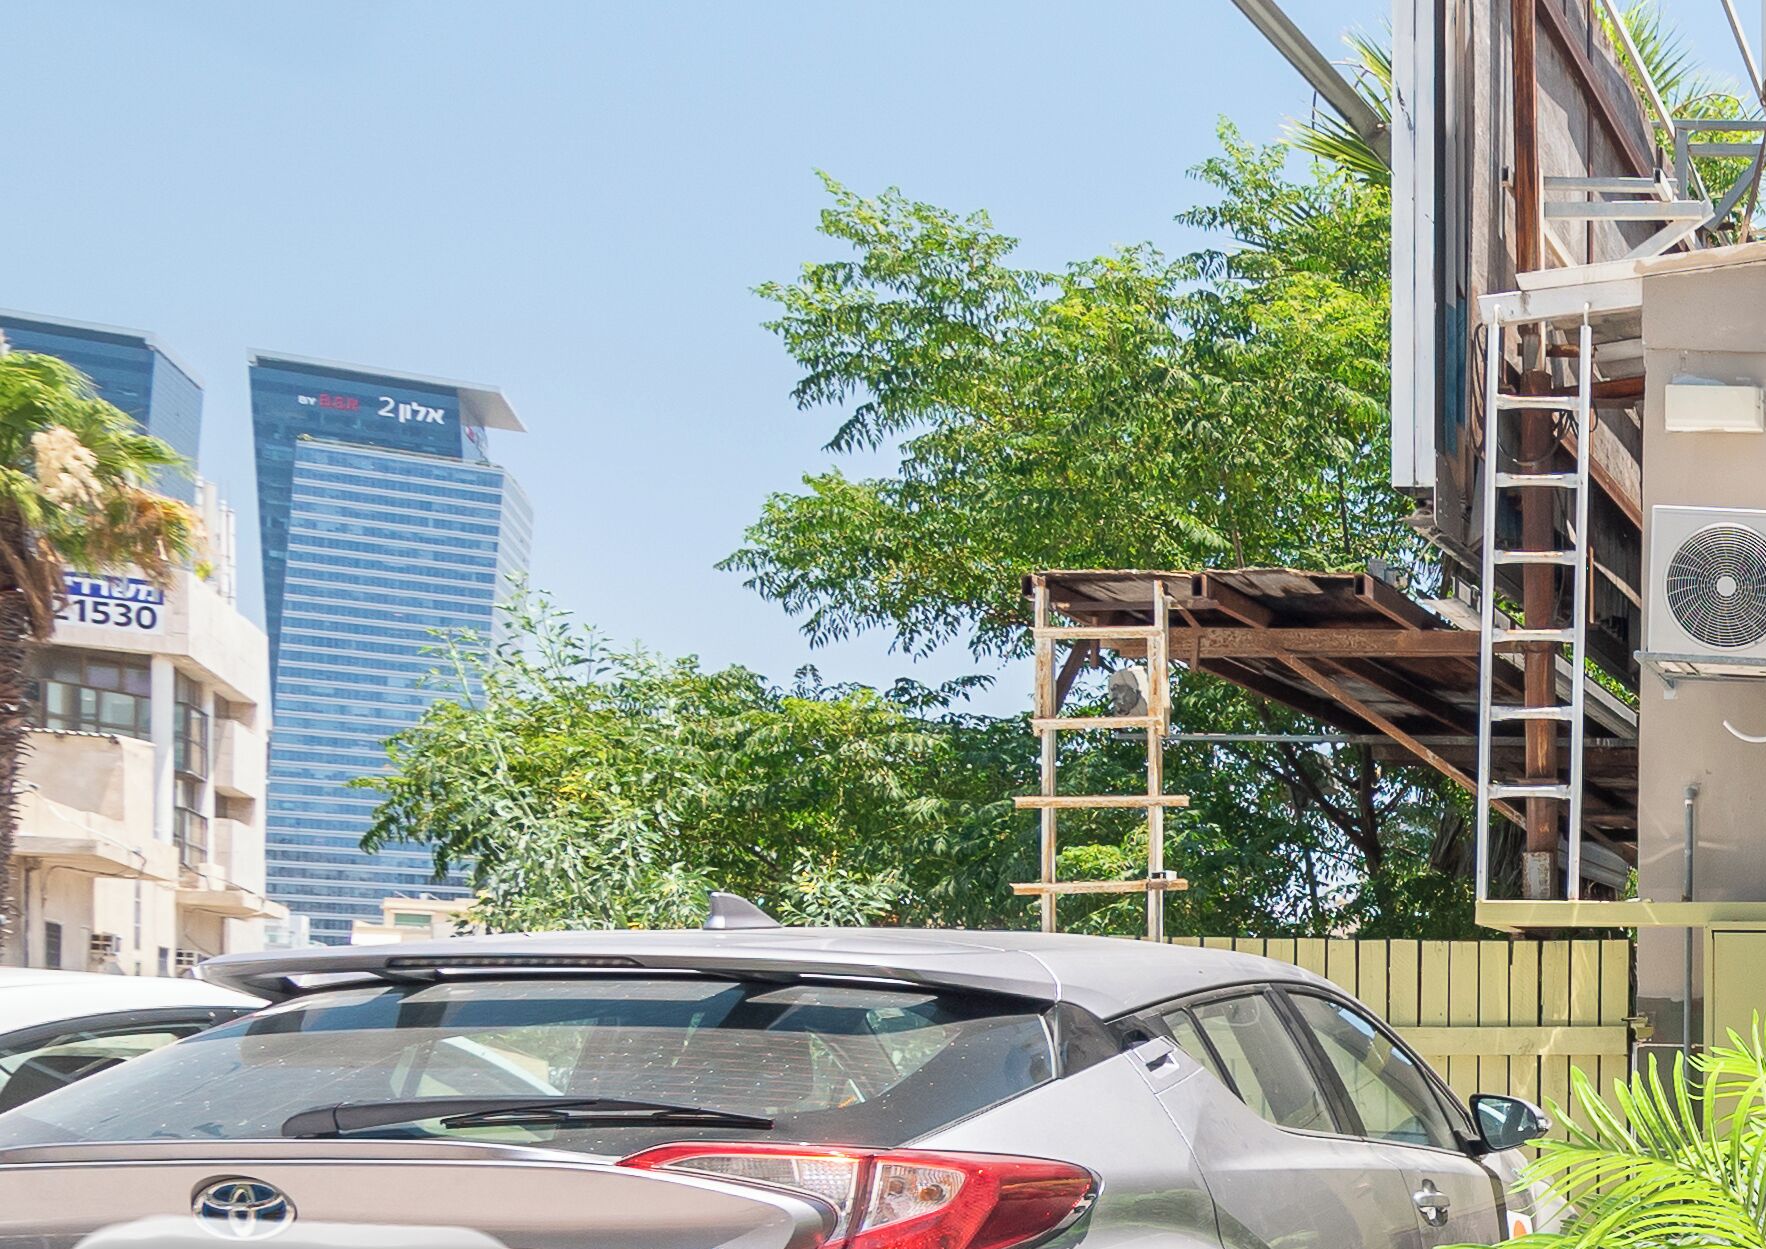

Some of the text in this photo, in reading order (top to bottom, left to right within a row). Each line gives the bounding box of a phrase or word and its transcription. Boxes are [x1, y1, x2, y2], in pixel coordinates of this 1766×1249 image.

[297, 394, 317, 406] BY
[377, 396, 445, 425] אלון 2
